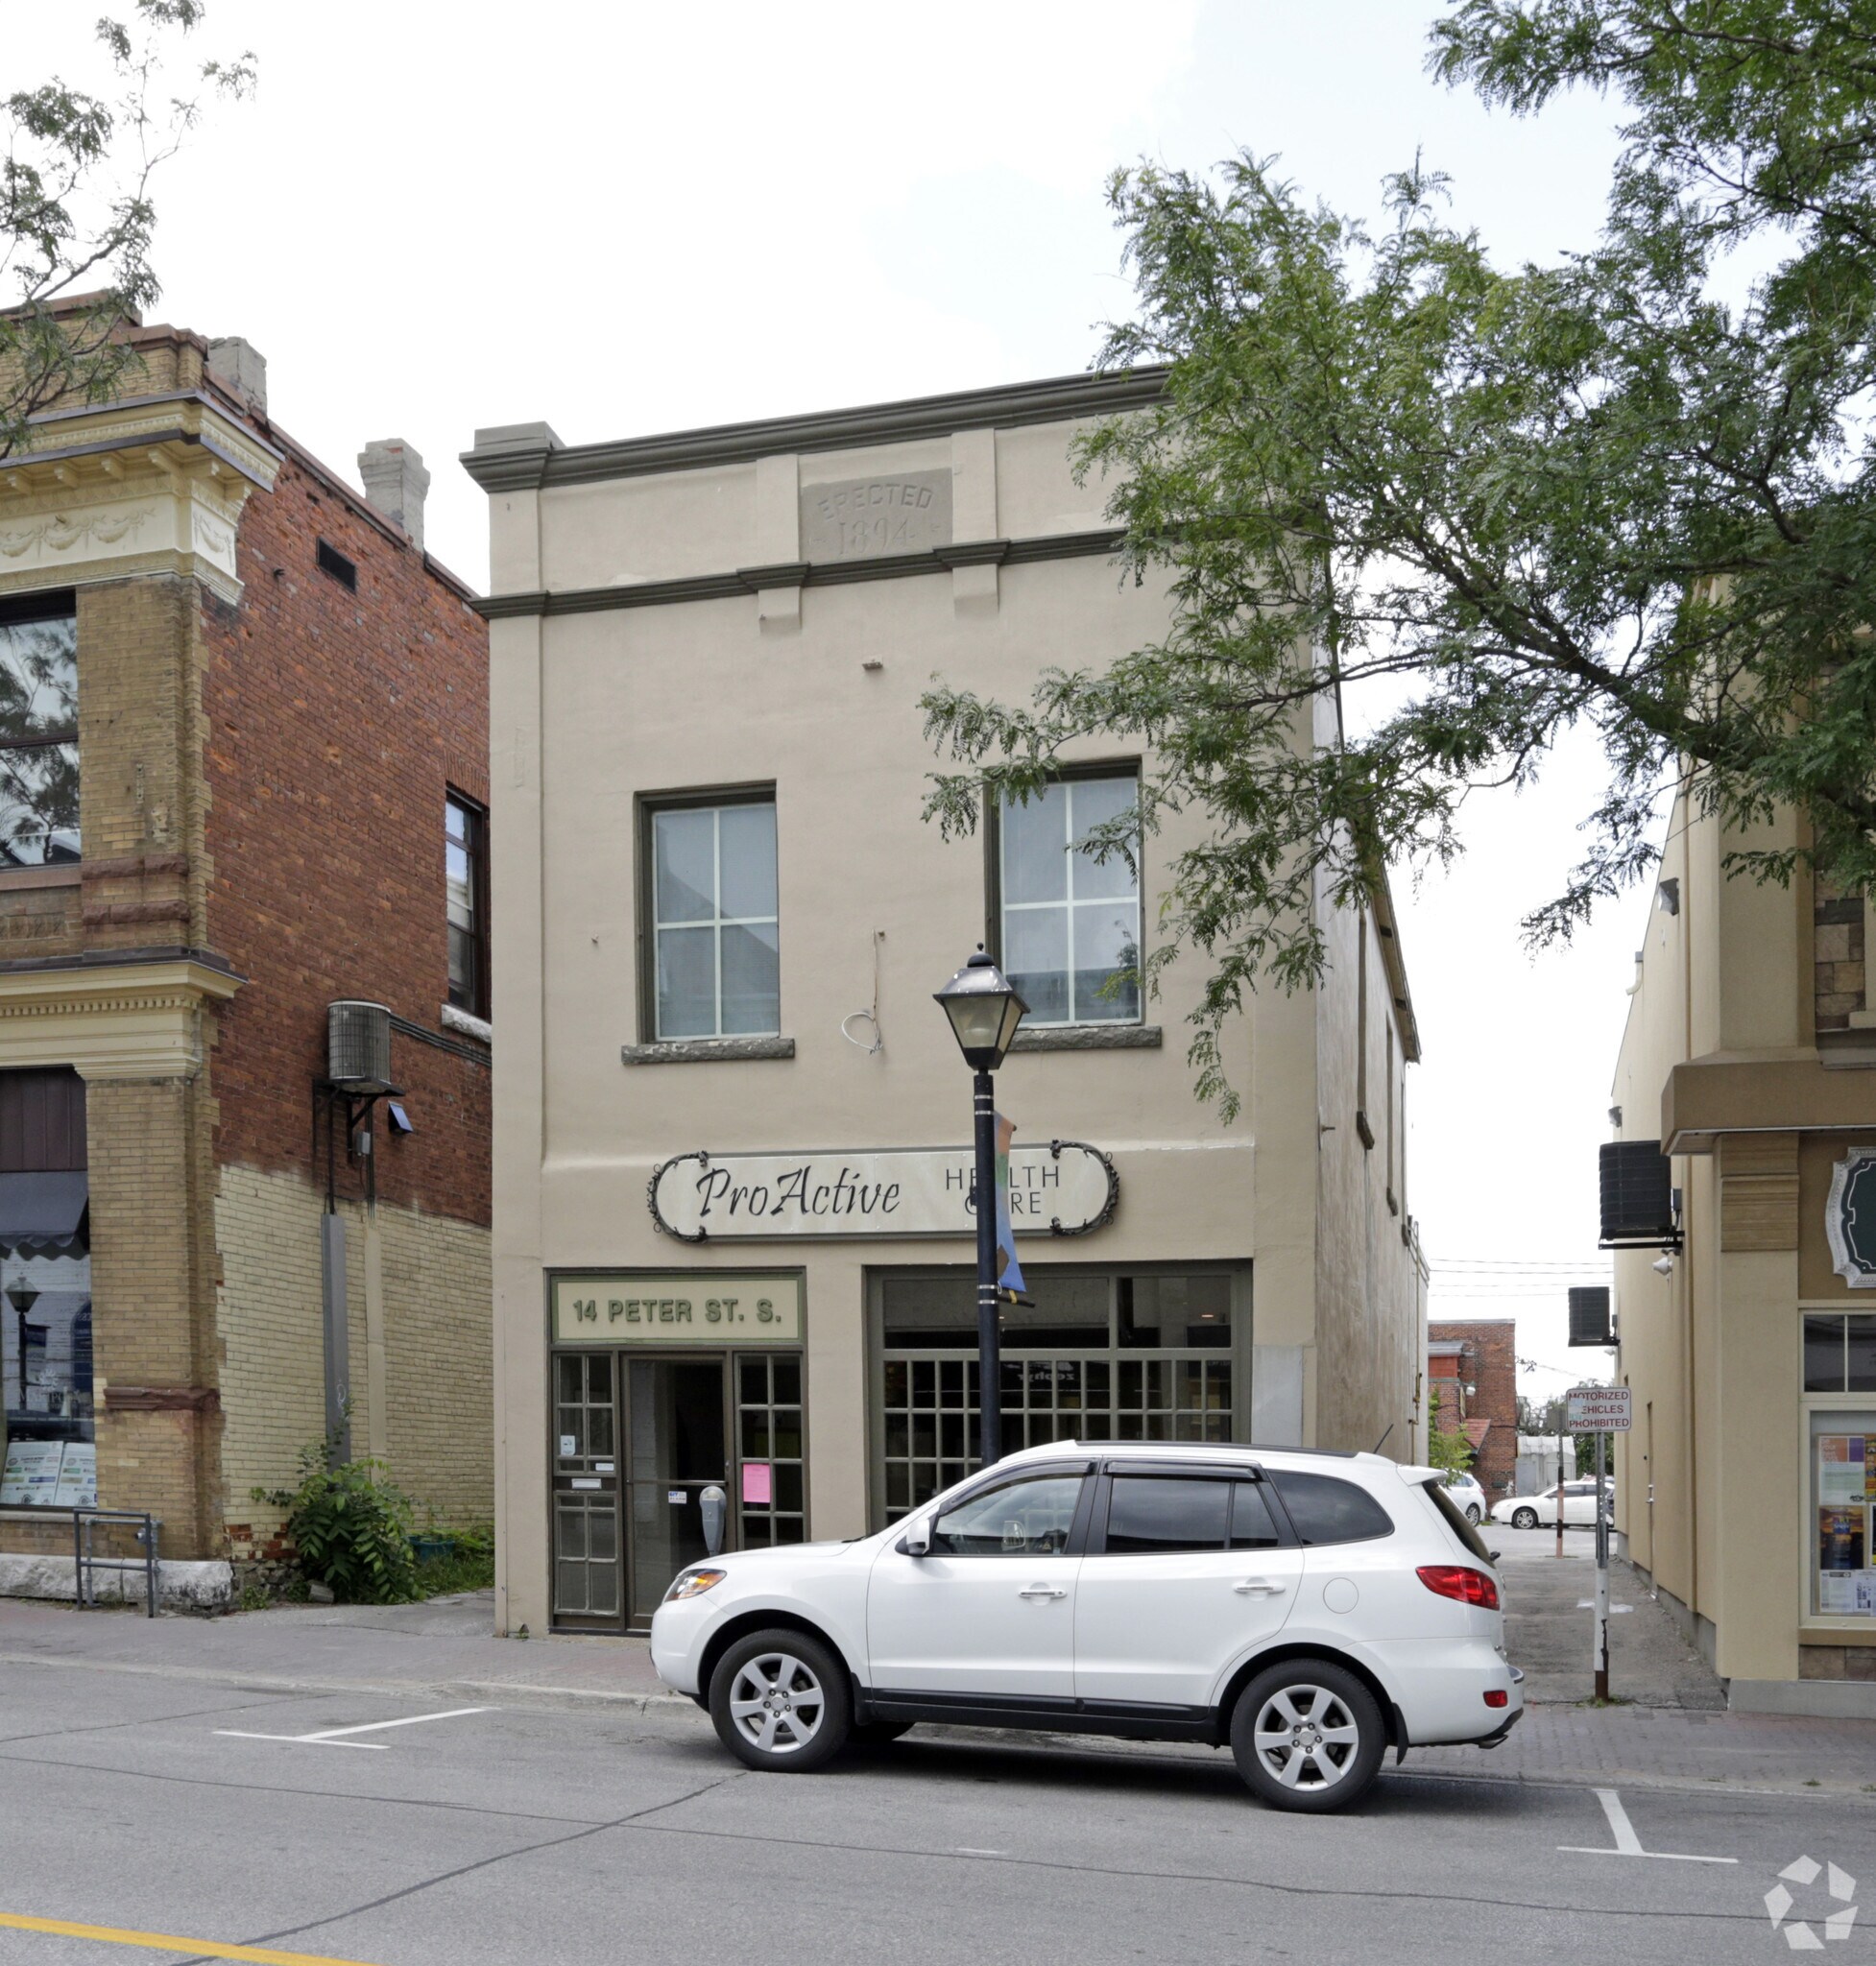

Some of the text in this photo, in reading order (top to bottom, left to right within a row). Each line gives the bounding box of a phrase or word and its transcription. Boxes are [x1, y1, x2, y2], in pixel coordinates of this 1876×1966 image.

[817, 483, 933, 520] ERECTED
[946, 1165, 1059, 1190] HLTH
[696, 1164, 901, 1217] ProActive
[964, 1191, 1042, 1215] CRE
[572, 1298, 782, 1323] 14 PETER ST. S.
[1569, 1391, 1628, 1401] MOTORIZED
[1580, 1404, 1623, 1414] EHICLES
[1570, 1418, 1629, 1427] PROHIBITED
